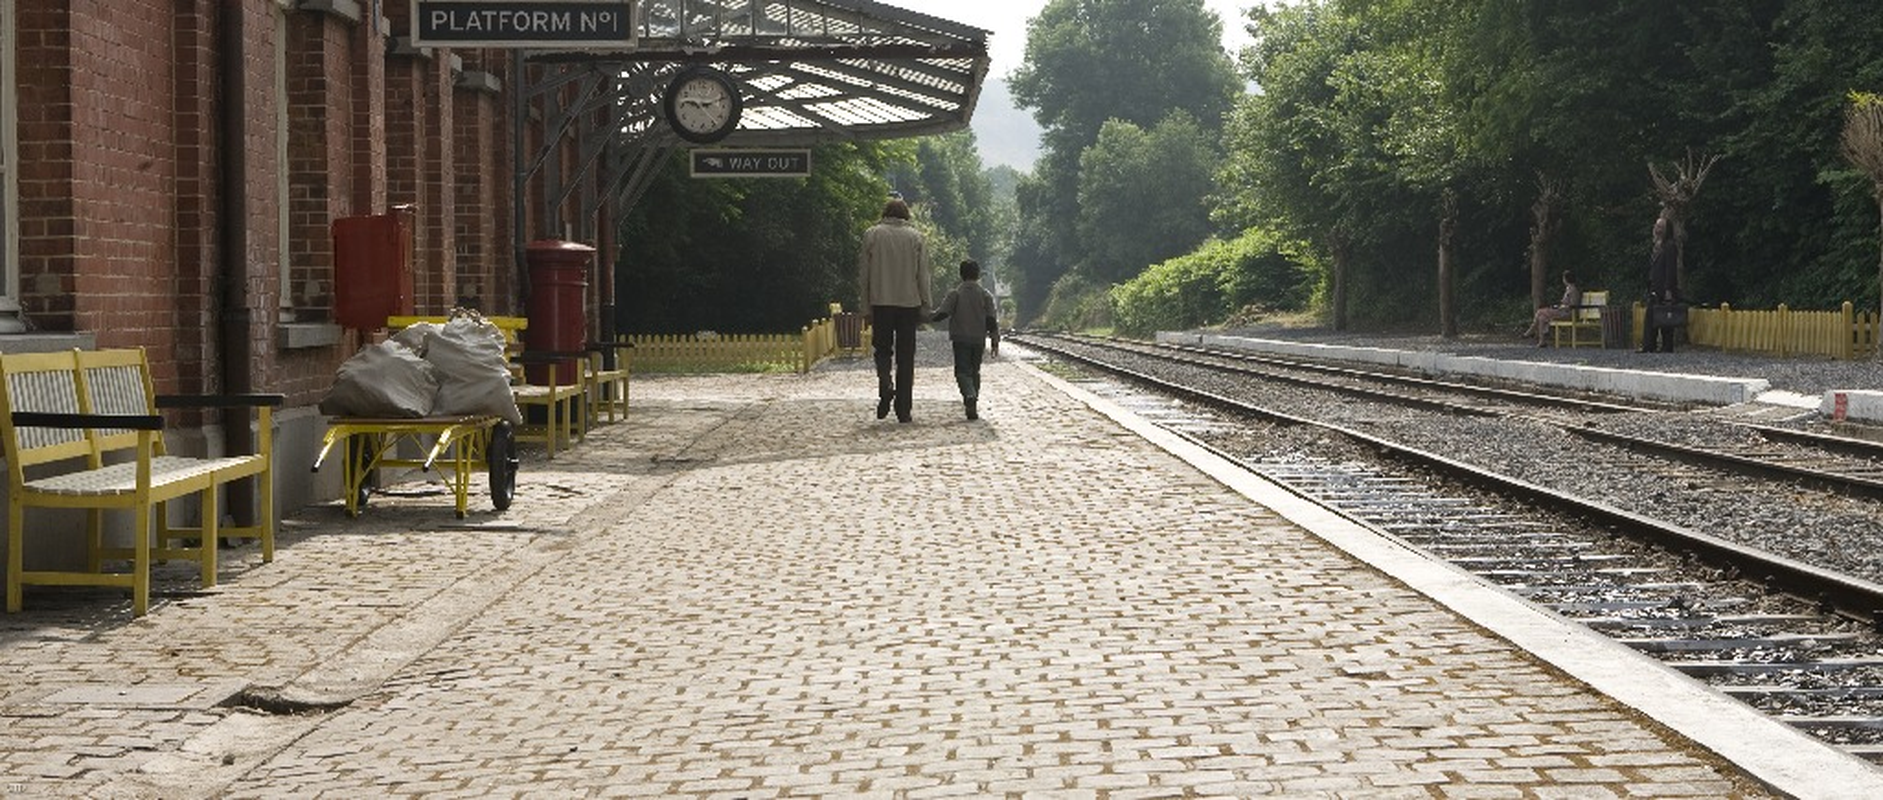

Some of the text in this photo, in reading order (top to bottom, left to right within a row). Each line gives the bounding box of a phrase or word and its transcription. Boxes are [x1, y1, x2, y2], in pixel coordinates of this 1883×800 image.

[431, 10, 570, 32] PLATFORM
[729, 157, 800, 170] WAY OUT
